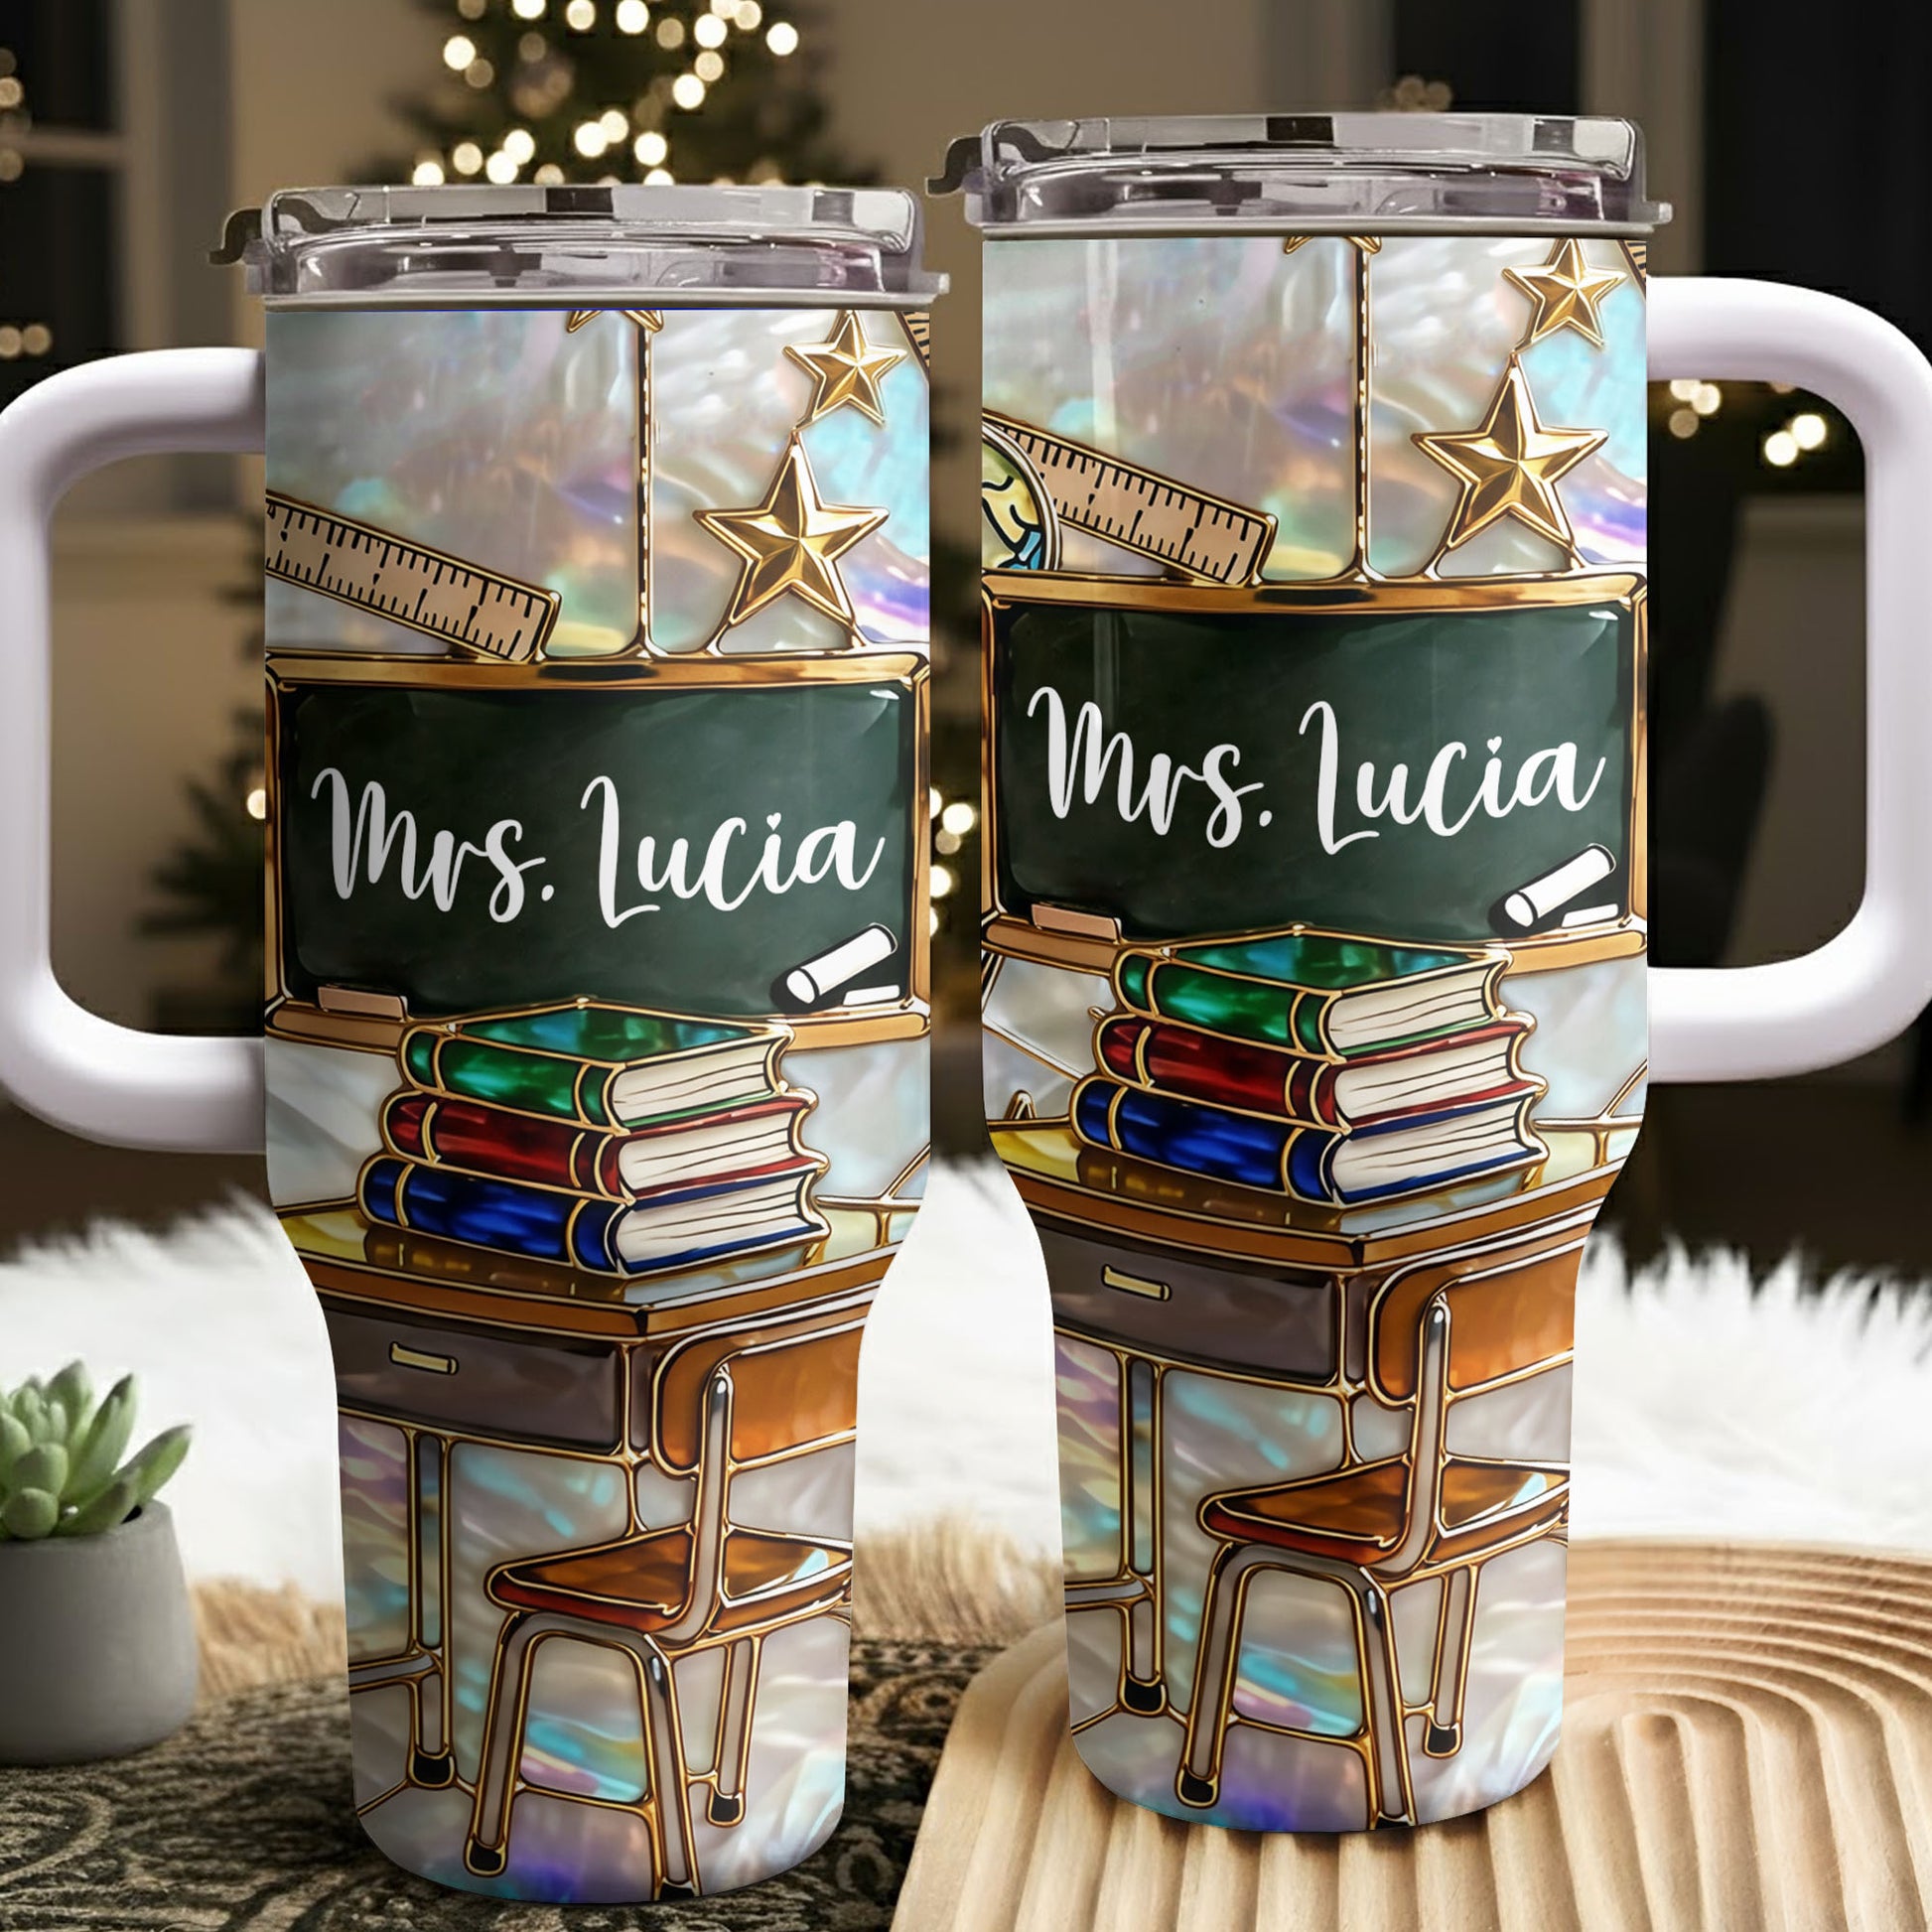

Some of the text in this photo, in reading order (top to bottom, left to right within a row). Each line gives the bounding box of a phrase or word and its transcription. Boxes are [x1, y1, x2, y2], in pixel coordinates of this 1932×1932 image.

[311, 767, 887, 930] Mrs. Lucia
[1027, 686, 1606, 856] Mrs. Lucia
